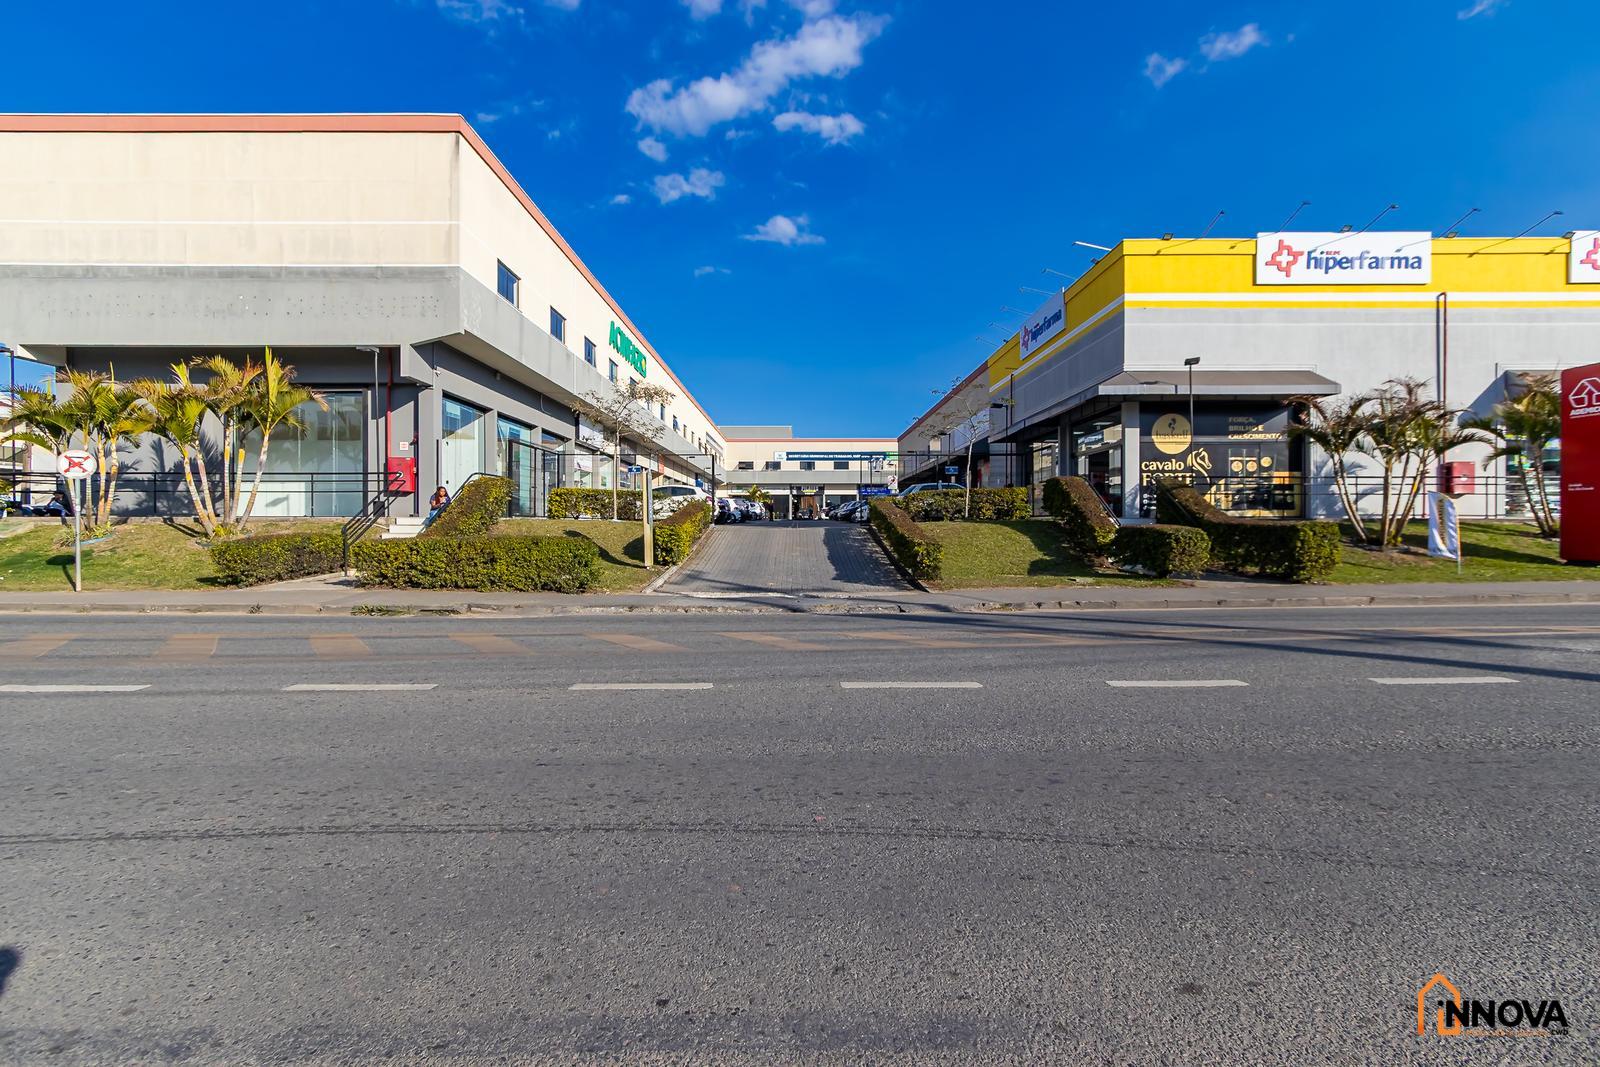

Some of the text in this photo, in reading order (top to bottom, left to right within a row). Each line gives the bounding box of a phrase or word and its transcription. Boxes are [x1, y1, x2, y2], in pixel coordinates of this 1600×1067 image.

[1306, 250, 1422, 275] hiperfarma
[1030, 309, 1062, 343] hiperfarma
[1141, 458, 1185, 471] cavalo
[1142, 472, 1196, 487] FOTE
